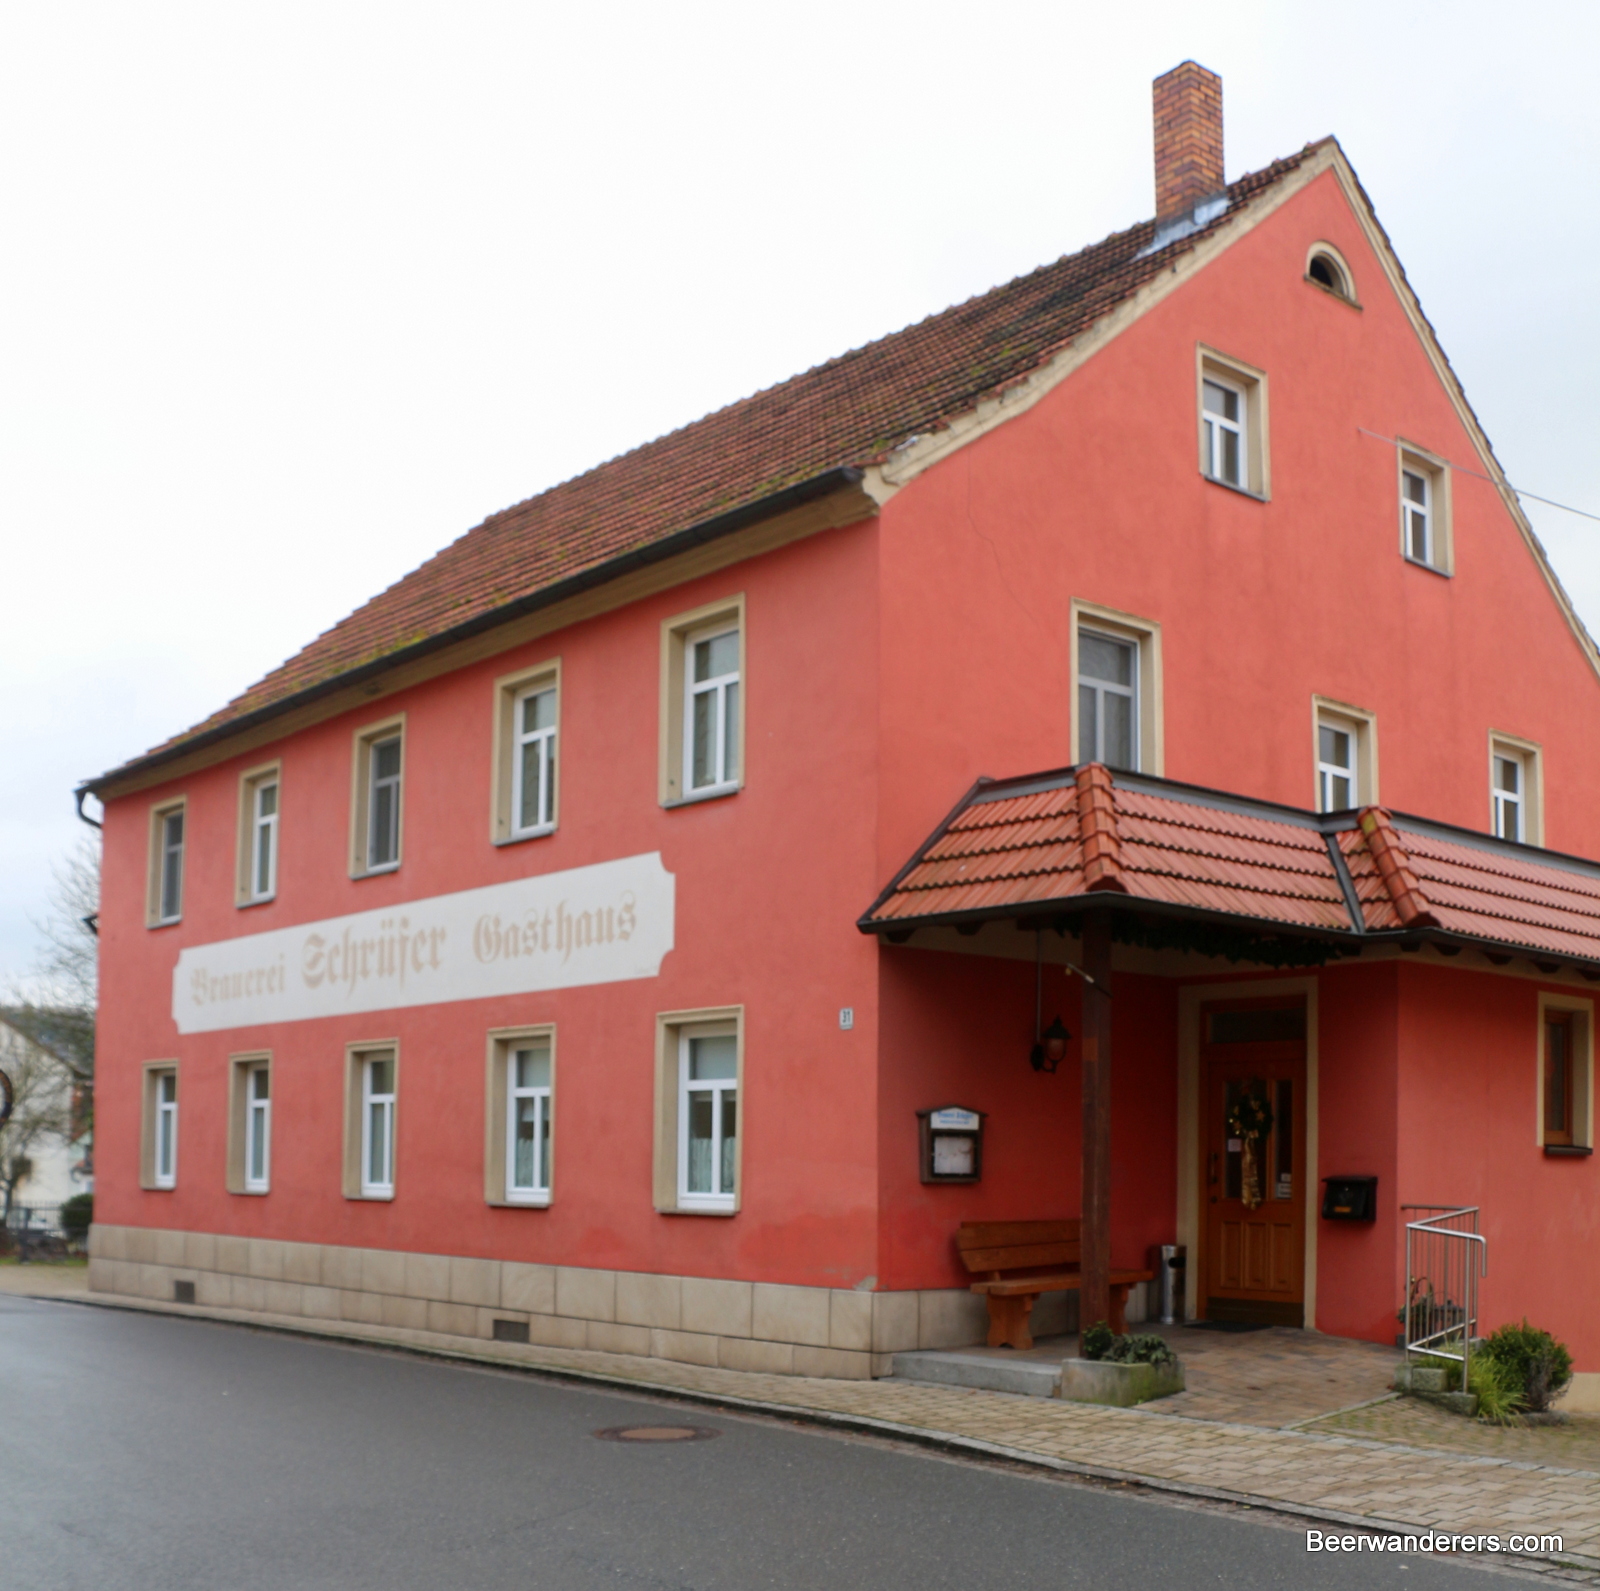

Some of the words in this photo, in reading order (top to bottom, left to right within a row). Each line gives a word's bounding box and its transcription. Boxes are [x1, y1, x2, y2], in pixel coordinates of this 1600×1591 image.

[190, 952, 285, 1007] Brauerei
[301, 916, 447, 999] Schrüfer
[472, 889, 637, 965] Gasthaus
